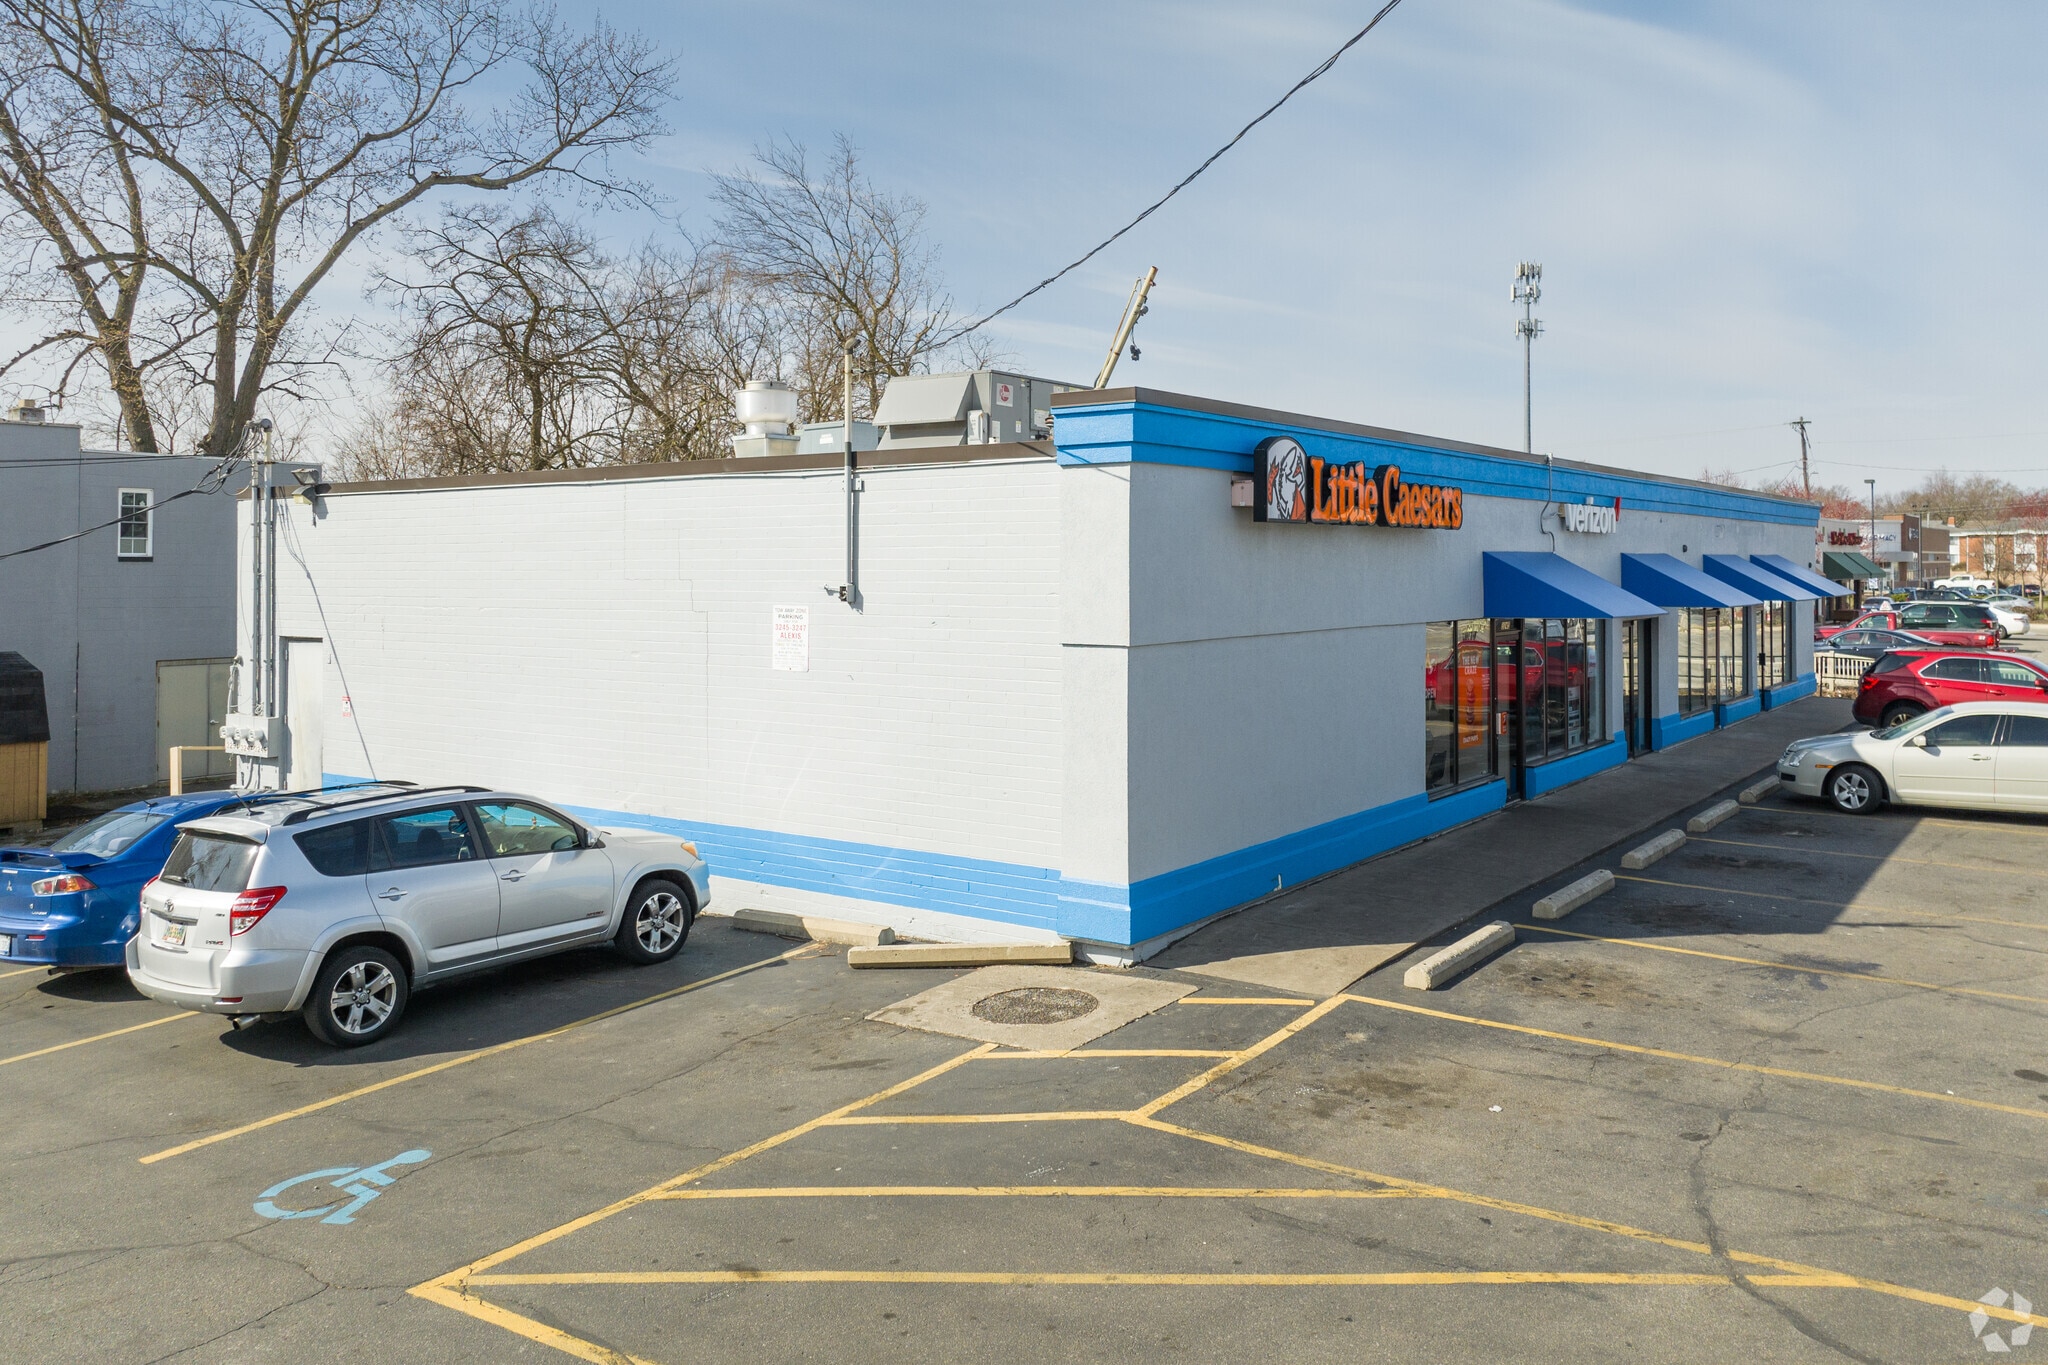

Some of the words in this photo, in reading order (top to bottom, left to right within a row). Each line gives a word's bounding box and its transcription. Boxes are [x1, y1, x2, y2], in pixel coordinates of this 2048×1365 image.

[1310, 457, 1378, 526] Little
[1381, 464, 1463, 530] Caesars
[1564, 496, 1617, 534] verizon
[780, 632, 802, 640] ALEXIS
